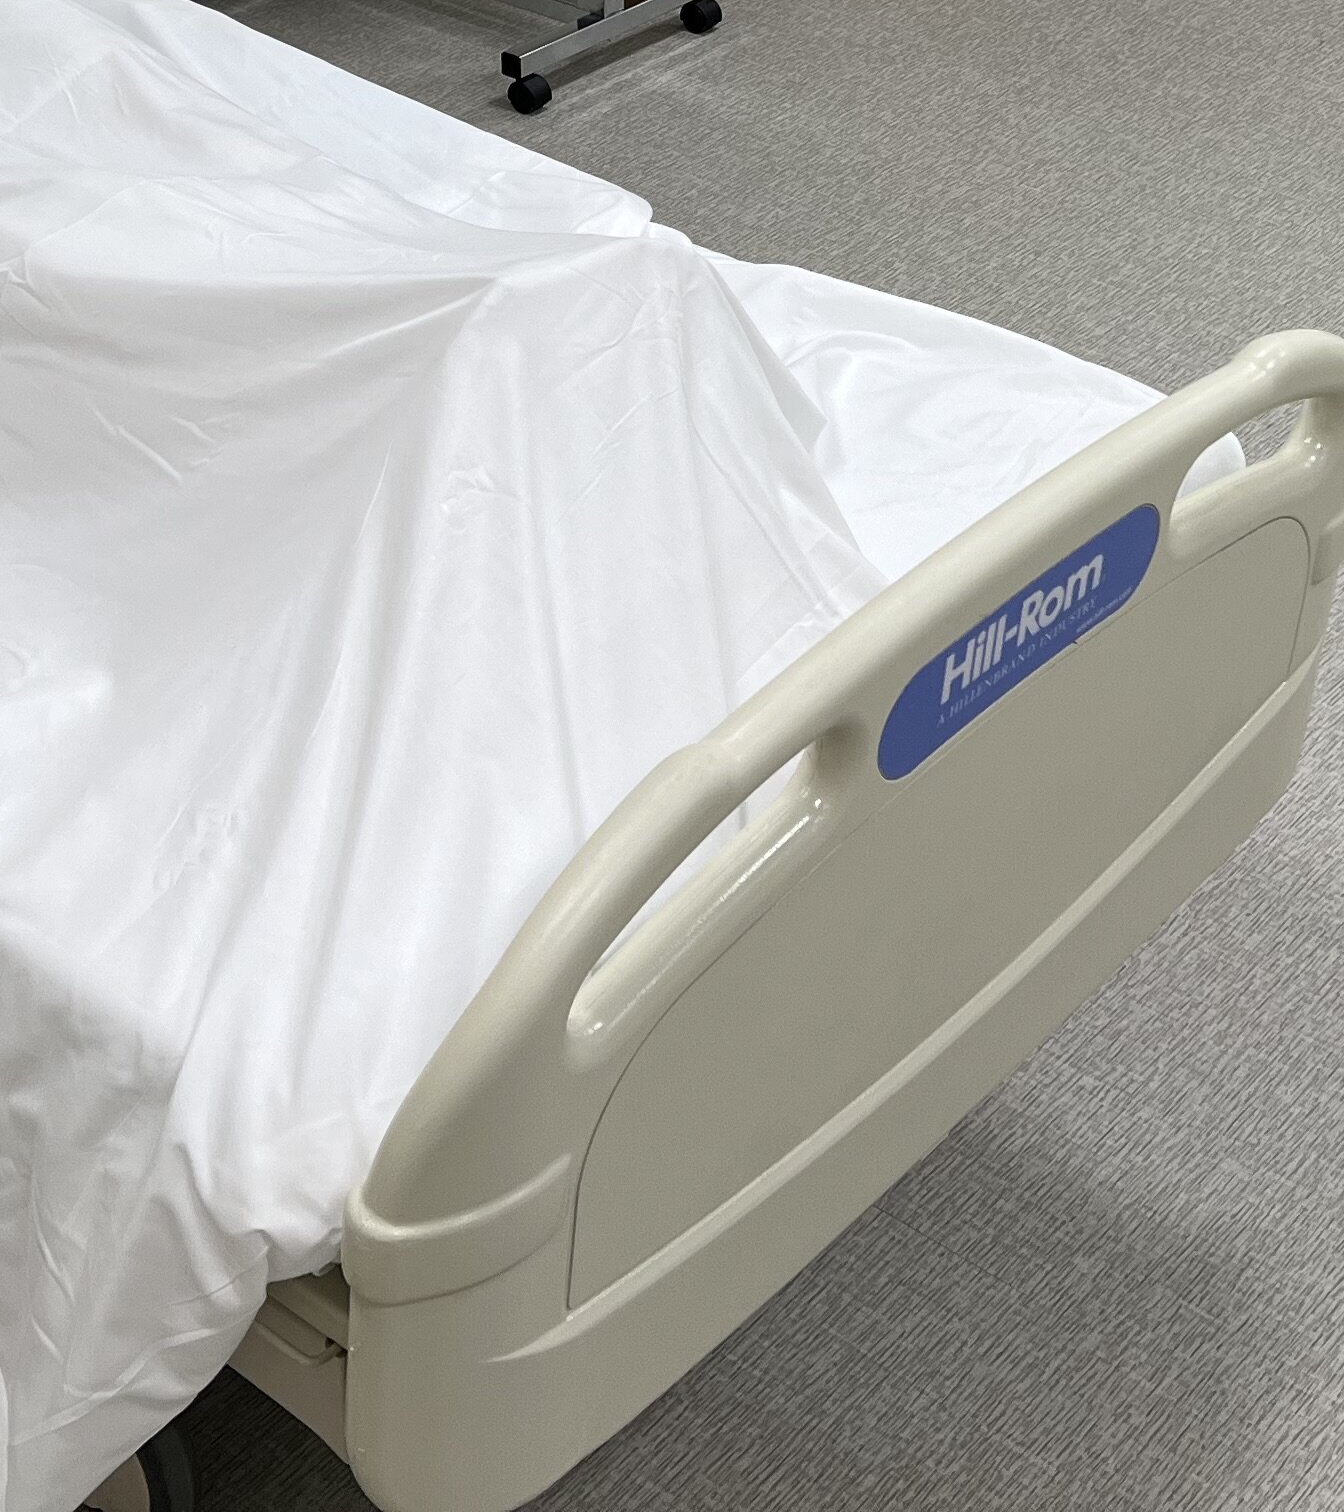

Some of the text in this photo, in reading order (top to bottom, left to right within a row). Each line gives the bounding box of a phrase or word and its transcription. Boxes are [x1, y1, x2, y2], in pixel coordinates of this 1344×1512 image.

[941, 554, 1103, 705] Hill-Rom
[949, 643, 1036, 719] HILLENBRAND
[1039, 596, 1097, 648] INDUSTRY
